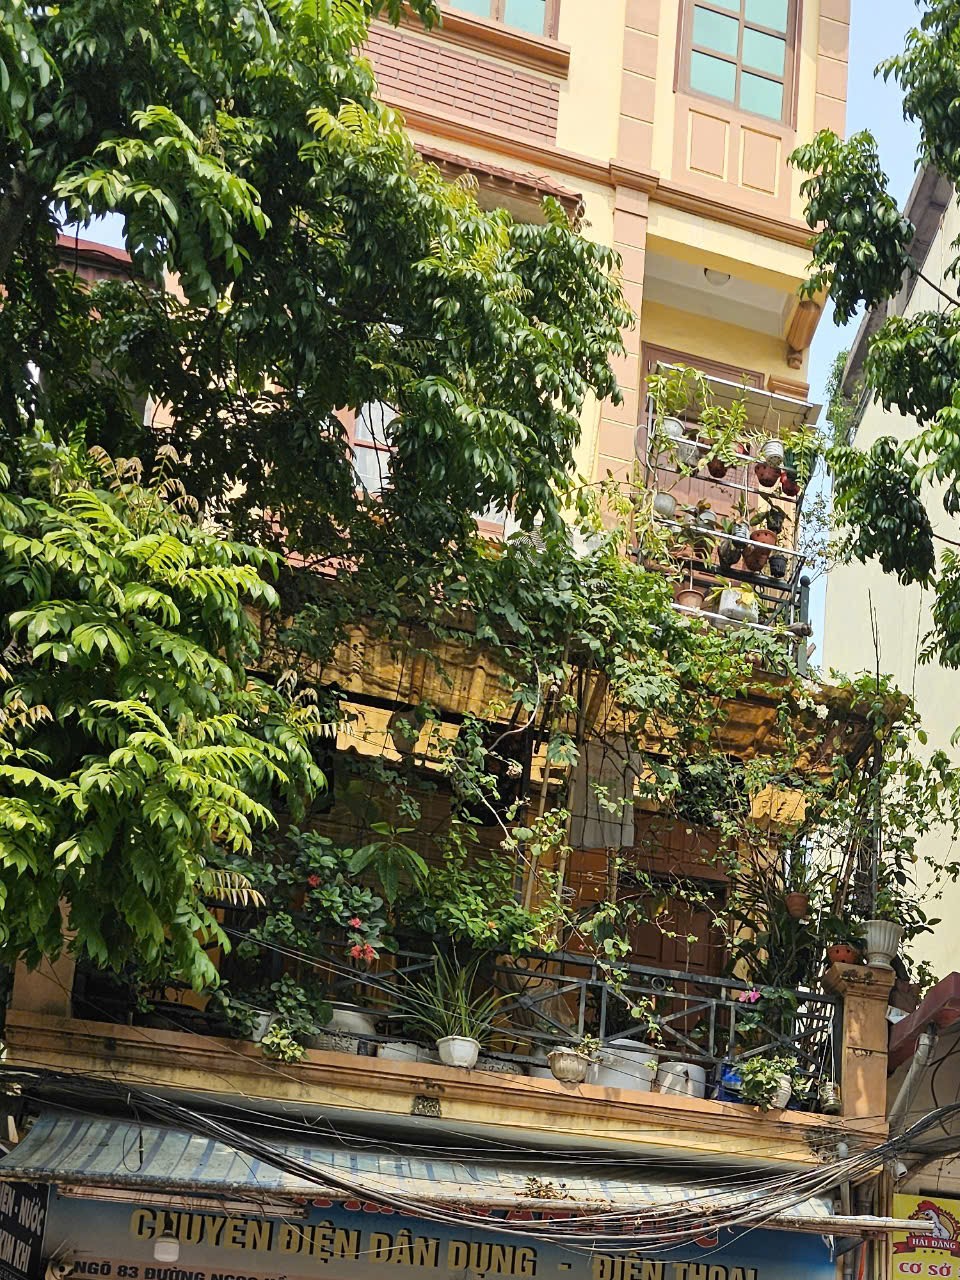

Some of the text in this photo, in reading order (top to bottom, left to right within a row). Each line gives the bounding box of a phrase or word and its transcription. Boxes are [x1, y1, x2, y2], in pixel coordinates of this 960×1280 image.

[18, 1195, 45, 1236] NƯỚC
[13, 1238, 32, 1273] KHÍ
[278, 1219, 361, 1264] ĐIỆN
[369, 1230, 440, 1268] DÂN
[447, 1239, 538, 1279] DỤNG
[74, 1261, 112, 1276] NGÕ
[117, 1264, 139, 1279] 83
[899, 1262, 922, 1274] CƠ
